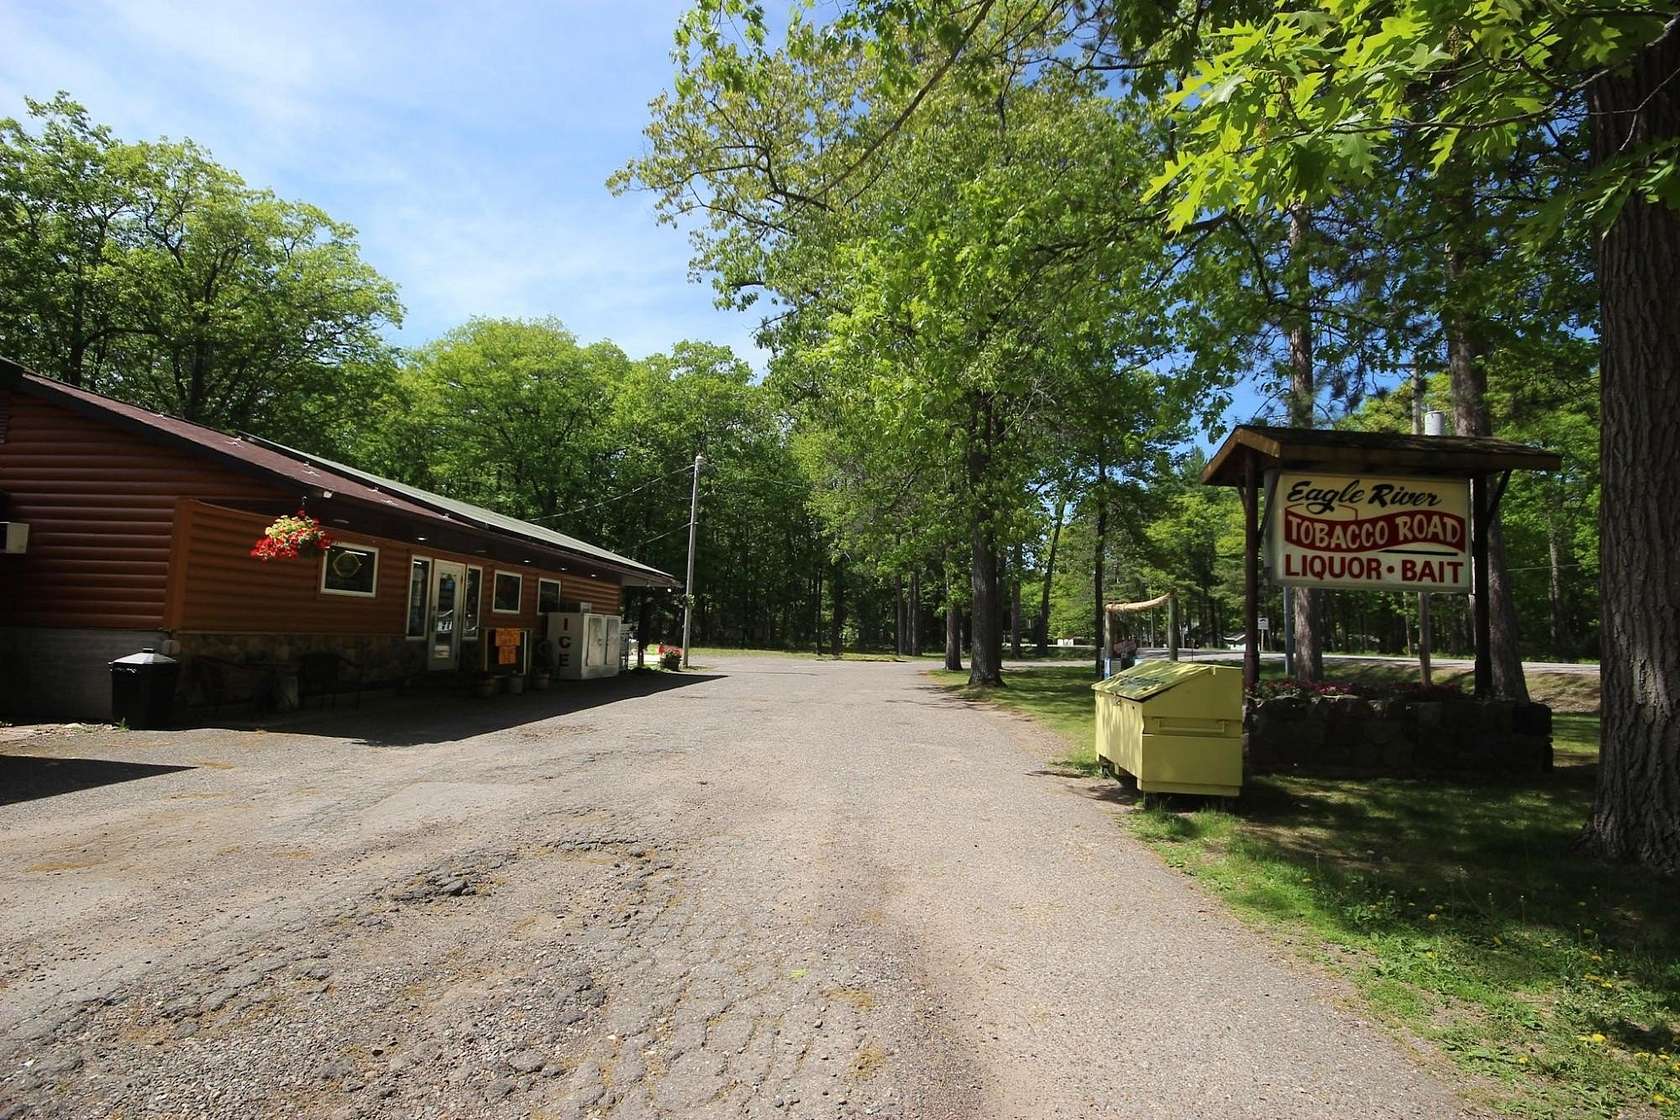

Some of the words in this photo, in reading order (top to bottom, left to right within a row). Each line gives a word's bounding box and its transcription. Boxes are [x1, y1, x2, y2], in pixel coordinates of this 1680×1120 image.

[1287, 479, 1365, 515] Eagle
[1368, 484, 1442, 508] River
[1287, 515, 1389, 549] TOBACCO
[1395, 514, 1461, 543] ROAD
[1285, 554, 1382, 580] LIQUOR
[1401, 559, 1464, 584] BAIT
[558, 618, 571, 667] ICE
